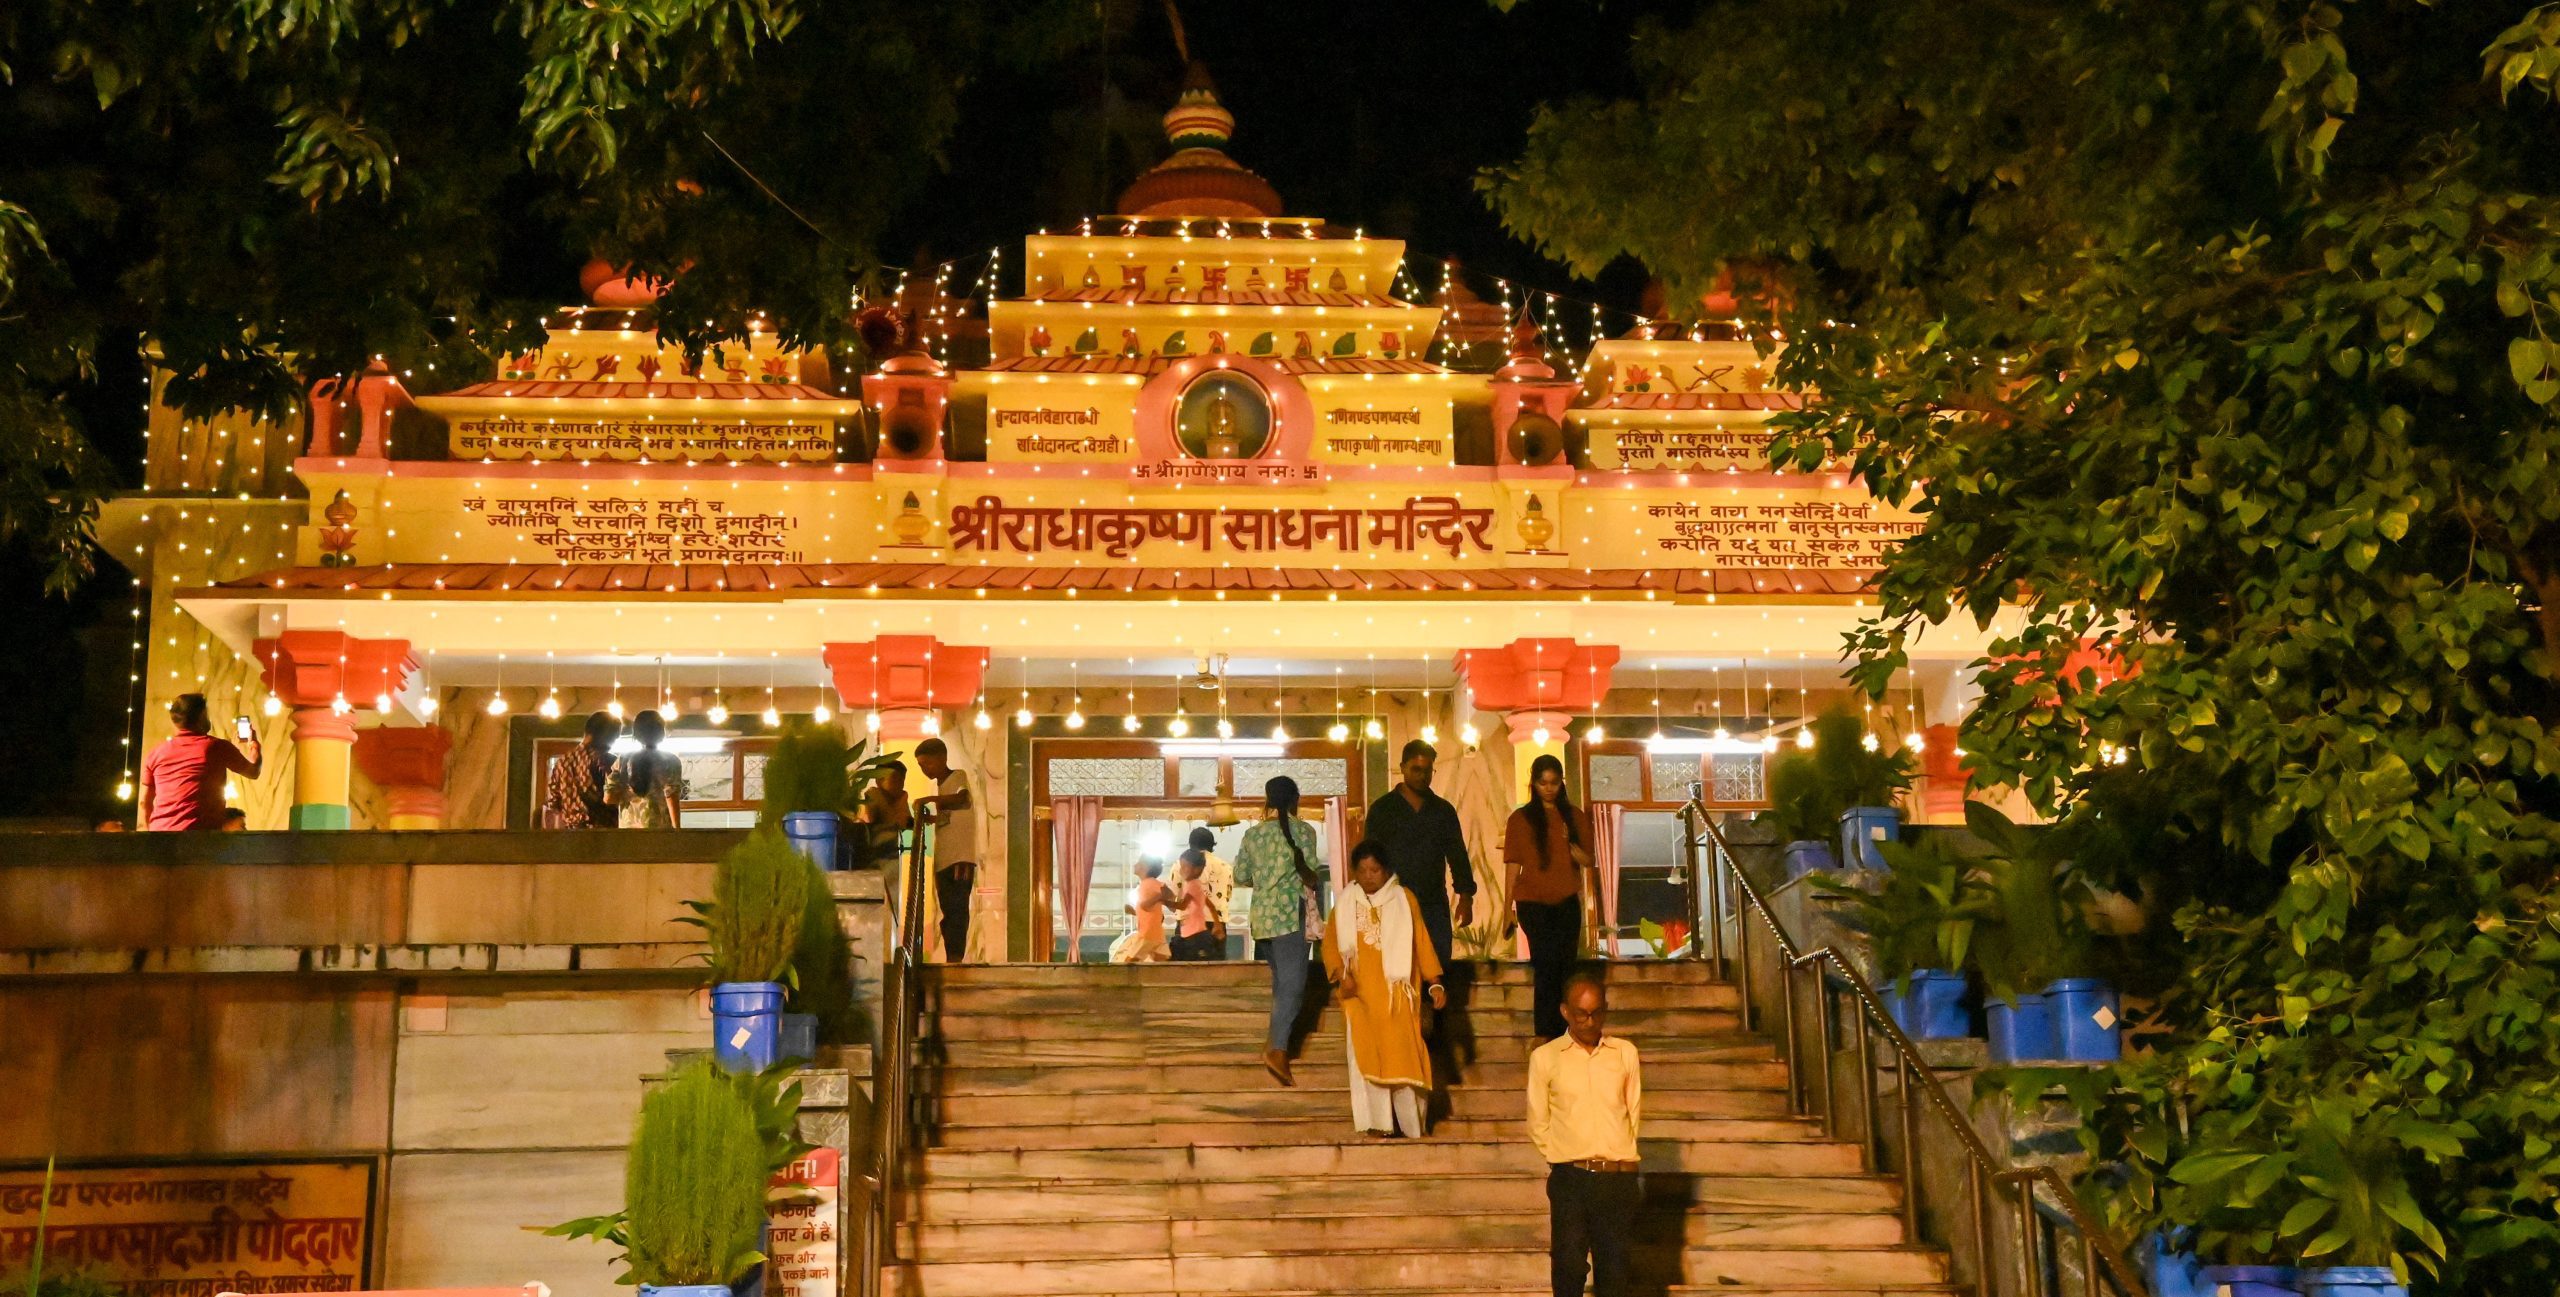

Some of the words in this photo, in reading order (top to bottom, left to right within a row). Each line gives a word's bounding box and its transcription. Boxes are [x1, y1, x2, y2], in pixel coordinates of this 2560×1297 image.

[460, 437, 493, 450] सदा
[1617, 445, 1655, 462] पुरतो
[1154, 459, 1248, 480] श्रीगणेशाय
[463, 496, 486, 511] खं
[587, 497, 648, 514] सलिलं
[706, 501, 725, 513] च
[1648, 502, 1701, 518] कायेन
[1710, 505, 1749, 518] वाचा
[656, 513, 706, 532] दिशो
[948, 495, 1216, 558] श्रीराधाकृष्ण
[1221, 508, 1362, 552] साधना
[1366, 496, 1494, 558] मन्दिर
[727, 530, 786, 548] शरीरं
[1658, 534, 1721, 551] करोति
[641, 546, 673, 563] भूतं
[800, 1221, 817, 1241] में
[798, 1250, 816, 1264] और
